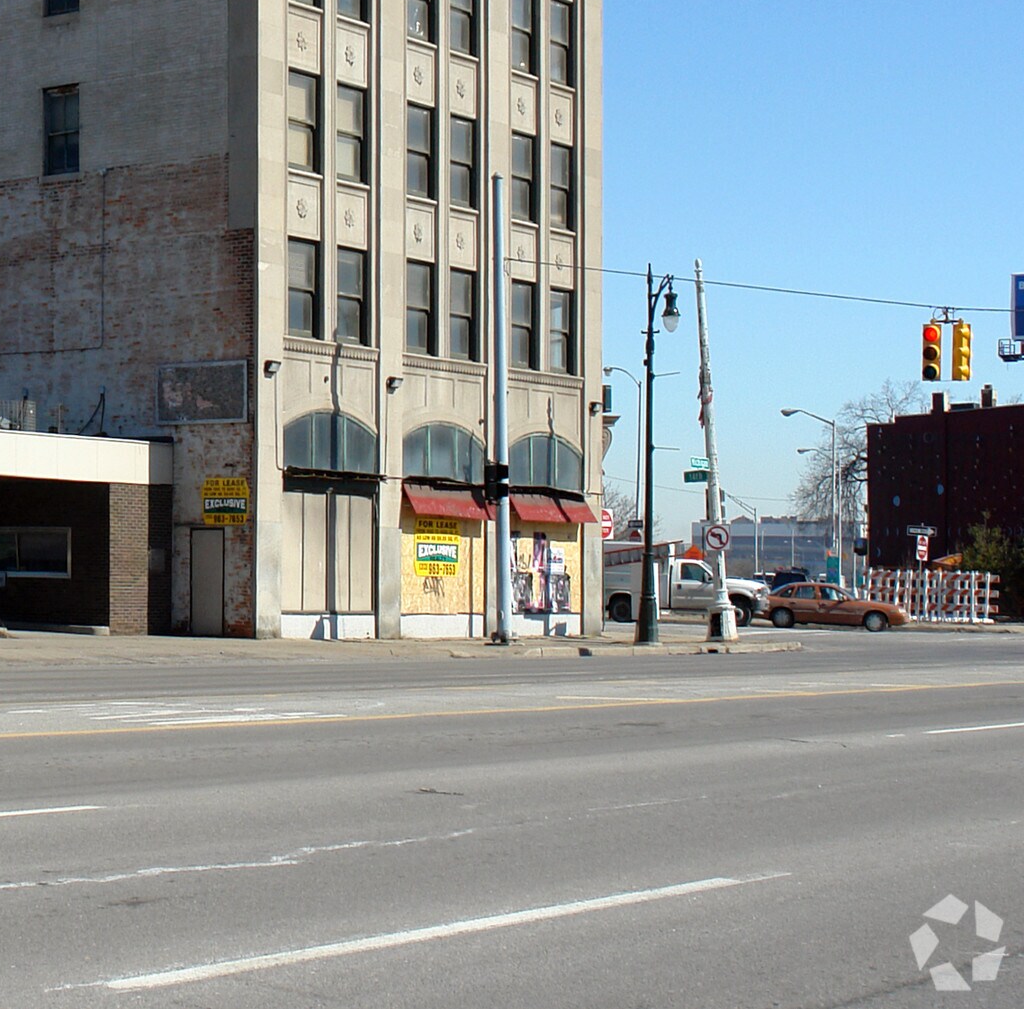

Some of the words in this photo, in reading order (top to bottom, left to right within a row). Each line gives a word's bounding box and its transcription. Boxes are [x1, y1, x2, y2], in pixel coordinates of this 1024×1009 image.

[206, 479, 220, 487] FOR
[223, 479, 245, 487] LEASE
[204, 498, 246, 510] EXCLUSIVE
[418, 520, 433, 528] FOR
[436, 520, 457, 529] LEASE
[418, 544, 457, 560] EXCLUSIVE
